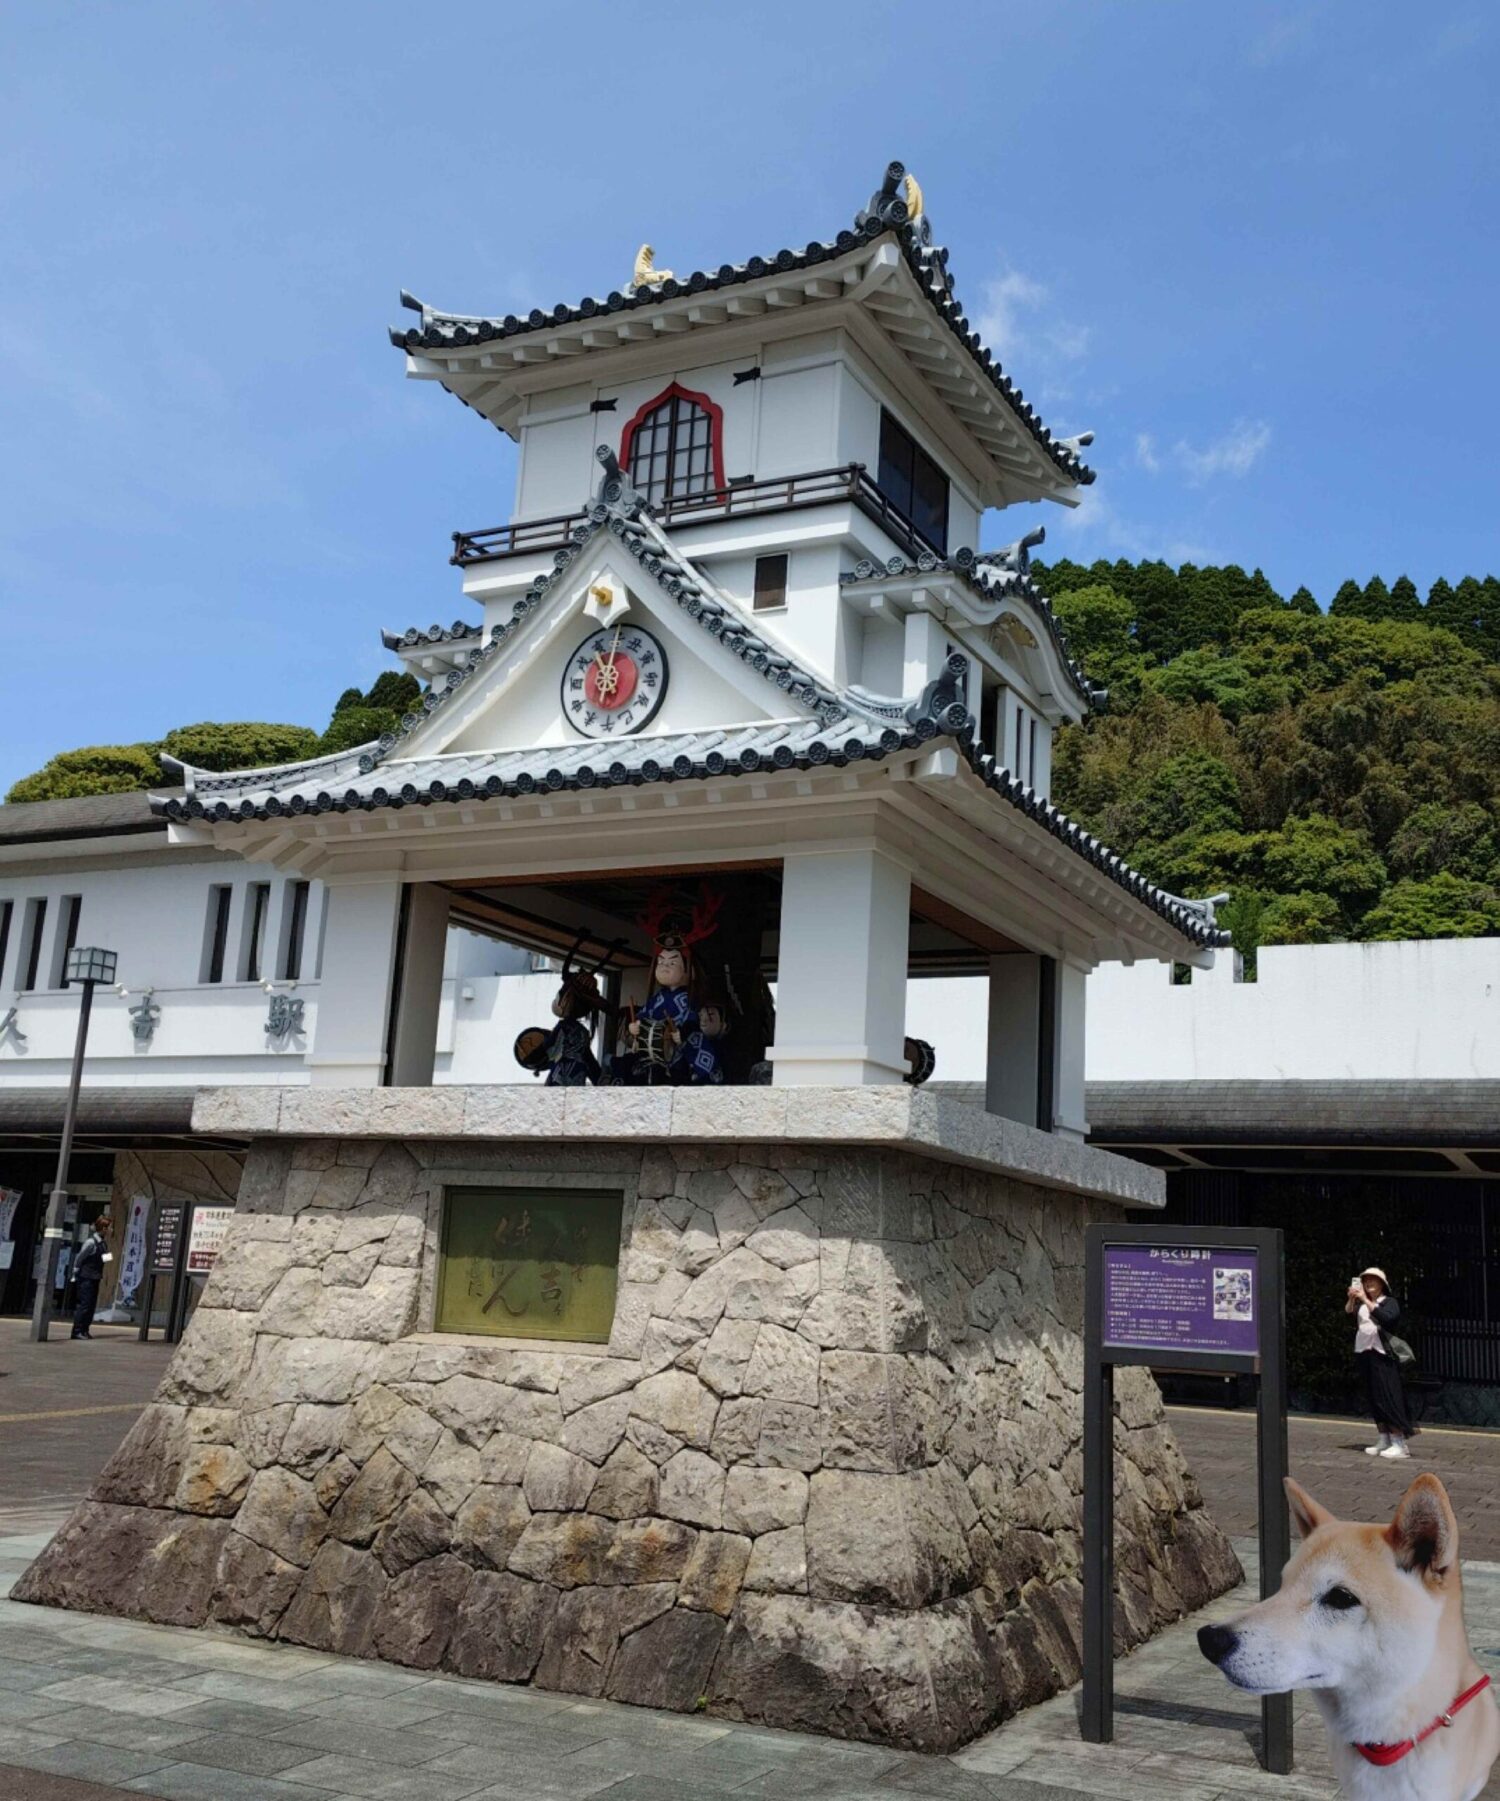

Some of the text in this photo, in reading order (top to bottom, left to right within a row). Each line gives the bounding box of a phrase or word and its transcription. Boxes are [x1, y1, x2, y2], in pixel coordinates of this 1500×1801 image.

[1149, 1248, 1212, 1260] からくり時計
